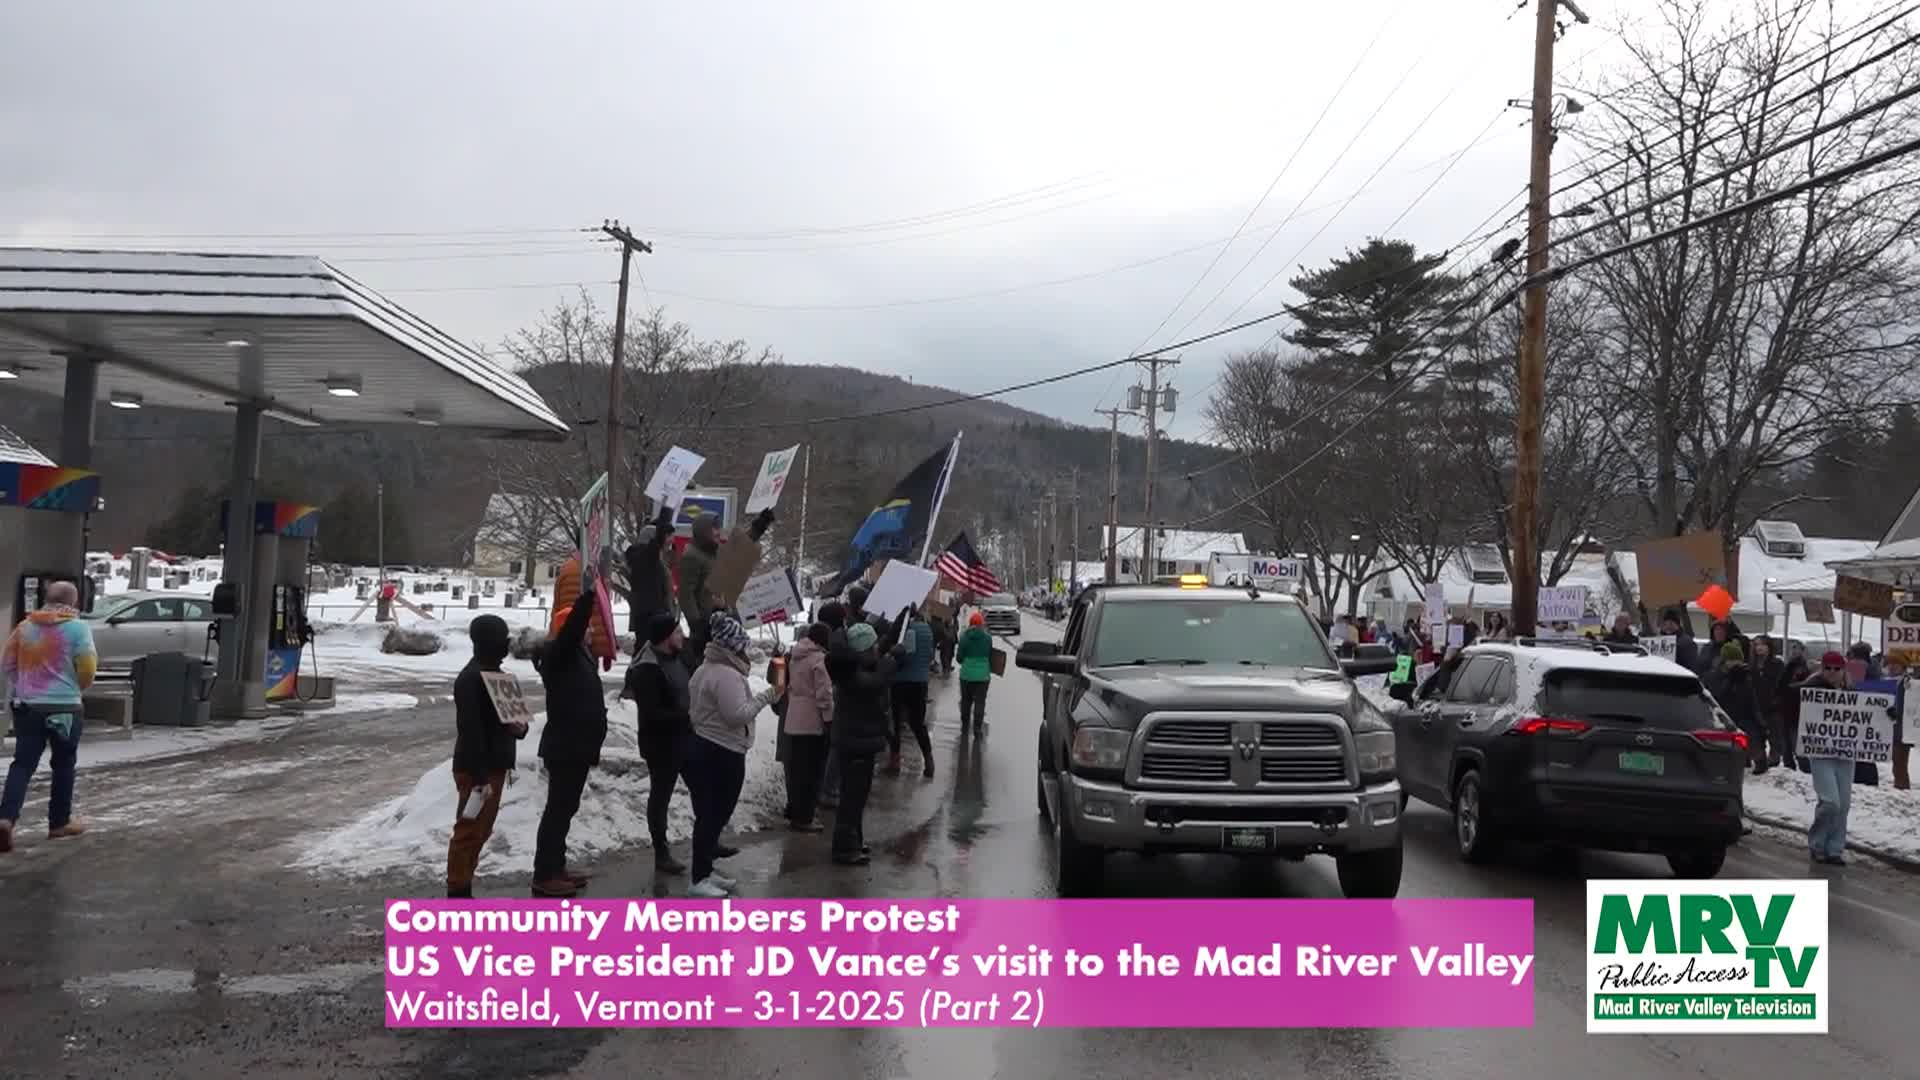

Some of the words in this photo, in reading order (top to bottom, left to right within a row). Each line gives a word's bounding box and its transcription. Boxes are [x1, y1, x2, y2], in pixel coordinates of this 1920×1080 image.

[1253, 561, 1297, 577] Mobil
[1800, 689, 1858, 706] MEMAW
[1865, 697, 1889, 708] AND
[1823, 709, 1873, 725] PAPAW
[1805, 722, 1858, 738] WOULD
[1801, 736, 1828, 746] VERY
[1832, 739, 1858, 749] VERY
[1862, 741, 1891, 753] VERY
[1803, 745, 1888, 763] DISAPPOINTED
